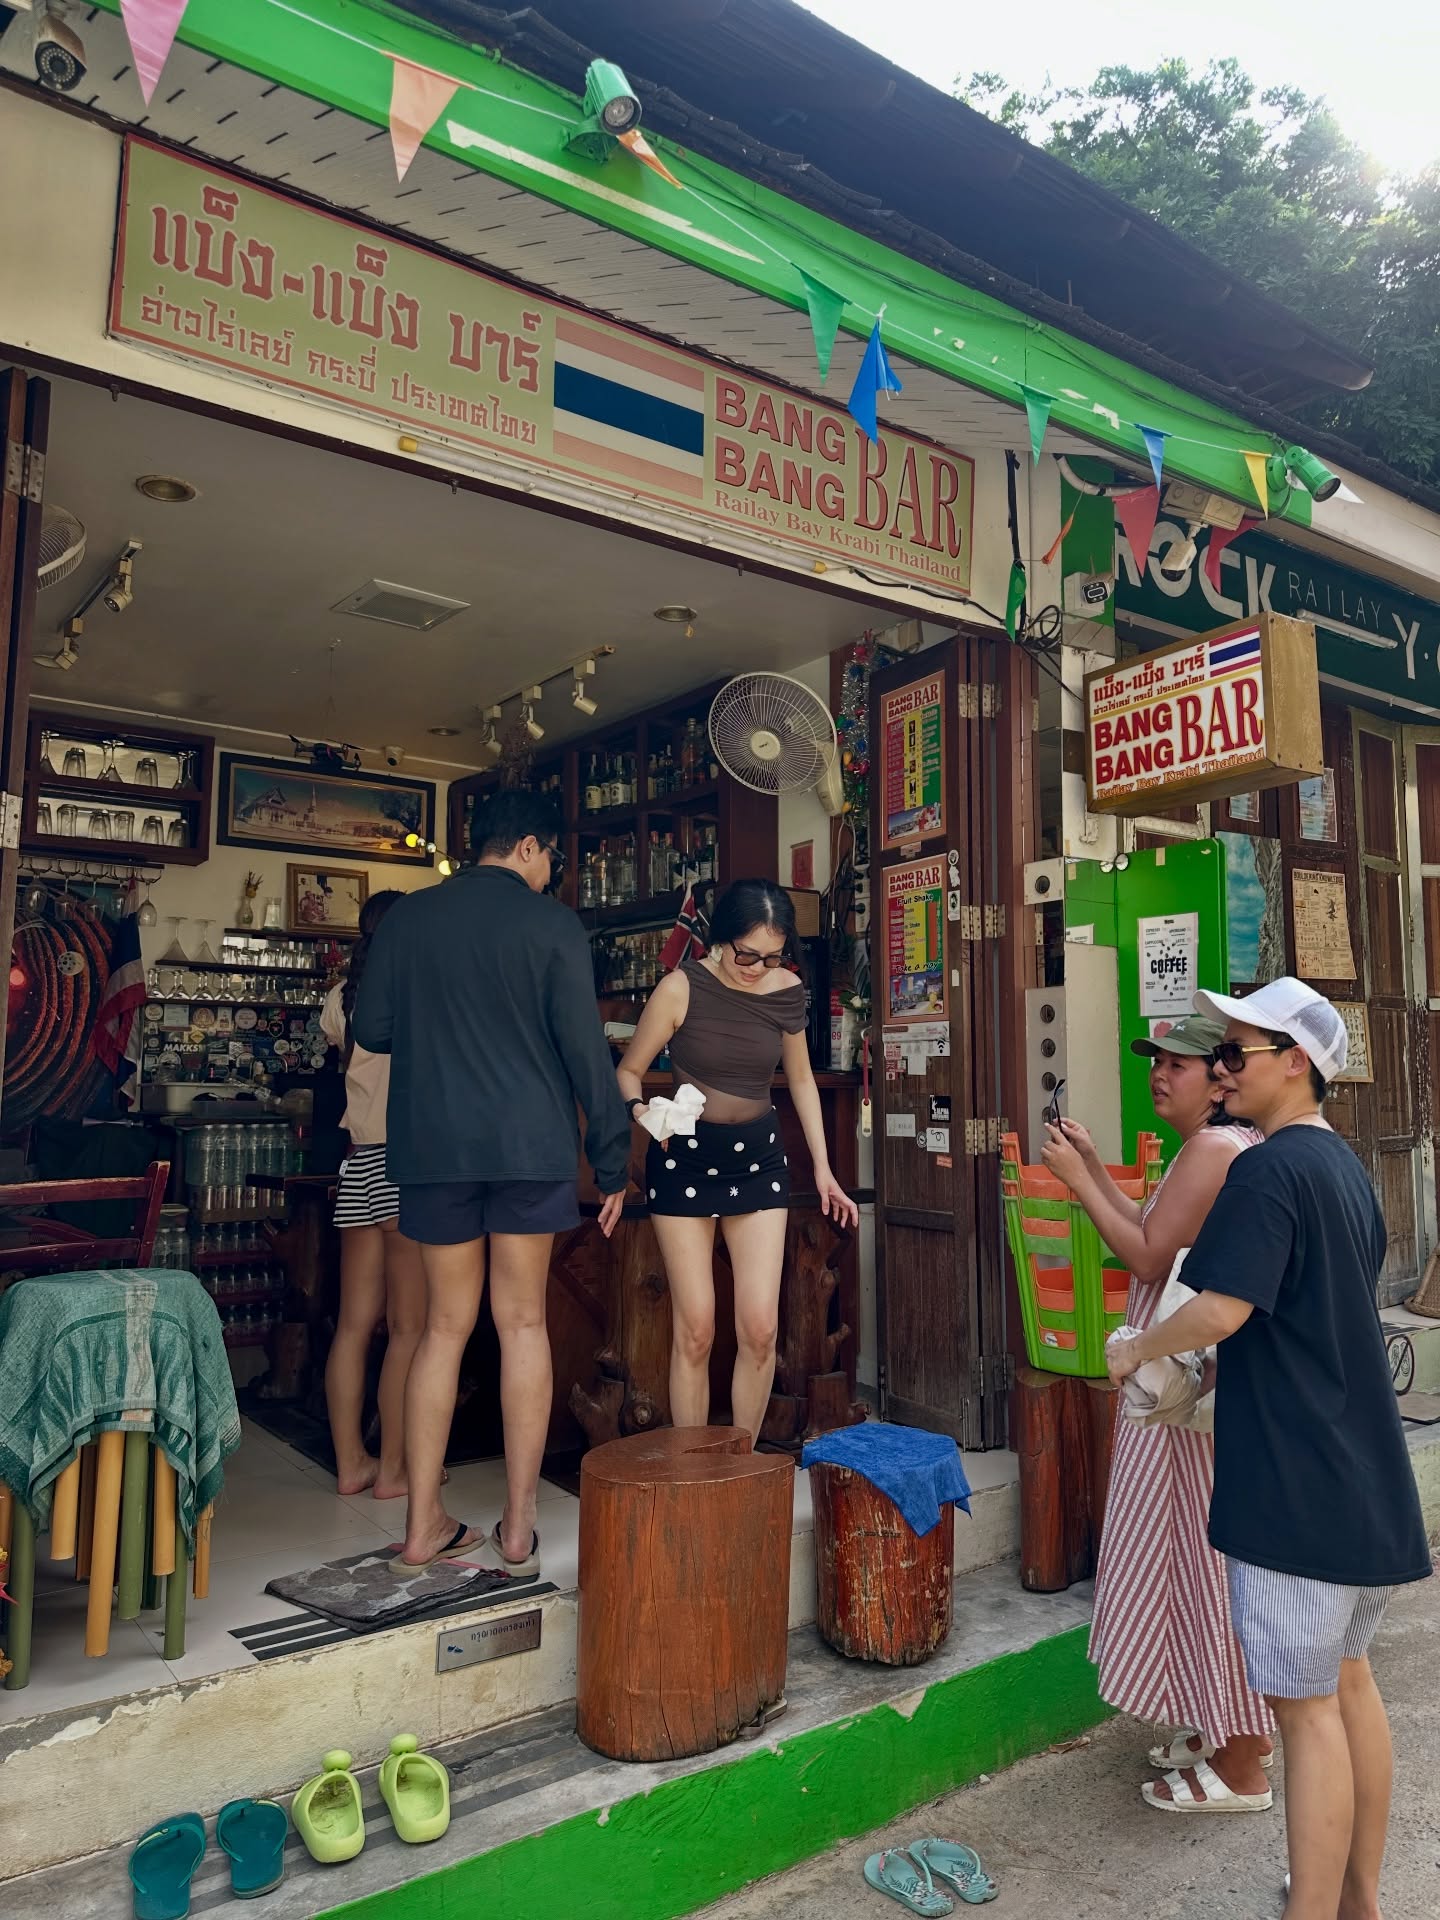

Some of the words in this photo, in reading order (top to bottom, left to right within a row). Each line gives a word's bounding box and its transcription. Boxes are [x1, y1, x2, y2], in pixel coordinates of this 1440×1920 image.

[152, 184, 420, 351] แบ็ง-แบ็ง
[448, 311, 541, 393] บาร์
[140, 286, 295, 368] อ่าวไร่เลย์
[307, 345, 377, 394] กระบี่
[391, 372, 537, 446] ประเทศไทย
[715, 376, 846, 465] BANG
[854, 427, 962, 559] BAR
[715, 435, 845, 521] BANG
[714, 489, 781, 526] Railay
[786, 511, 824, 539] Bay
[829, 525, 881, 557] Krabi
[885, 543, 961, 582] Thailand
[1288, 570, 1381, 630] RAILAY
[889, 694, 913, 709] BANG
[914, 683, 938, 708] BAR
[1094, 660, 1165, 703] แบ็ง-แบ็ง
[1173, 644, 1206, 677] บาร์
[889, 703, 913, 718] BANG
[1094, 702, 1173, 751] BANG
[1176, 676, 1264, 765] BAR
[1095, 738, 1174, 786] BANG
[1096, 781, 1135, 800] Railay
[1136, 774, 1162, 790] Bay
[1163, 763, 1200, 783] Krabi
[1202, 747, 1265, 773] Thailand
[890, 872, 914, 884] BANG
[915, 867, 940, 888] BAR
[890, 881, 914, 893] BANG
[1150, 956, 1188, 975] COFFEE
